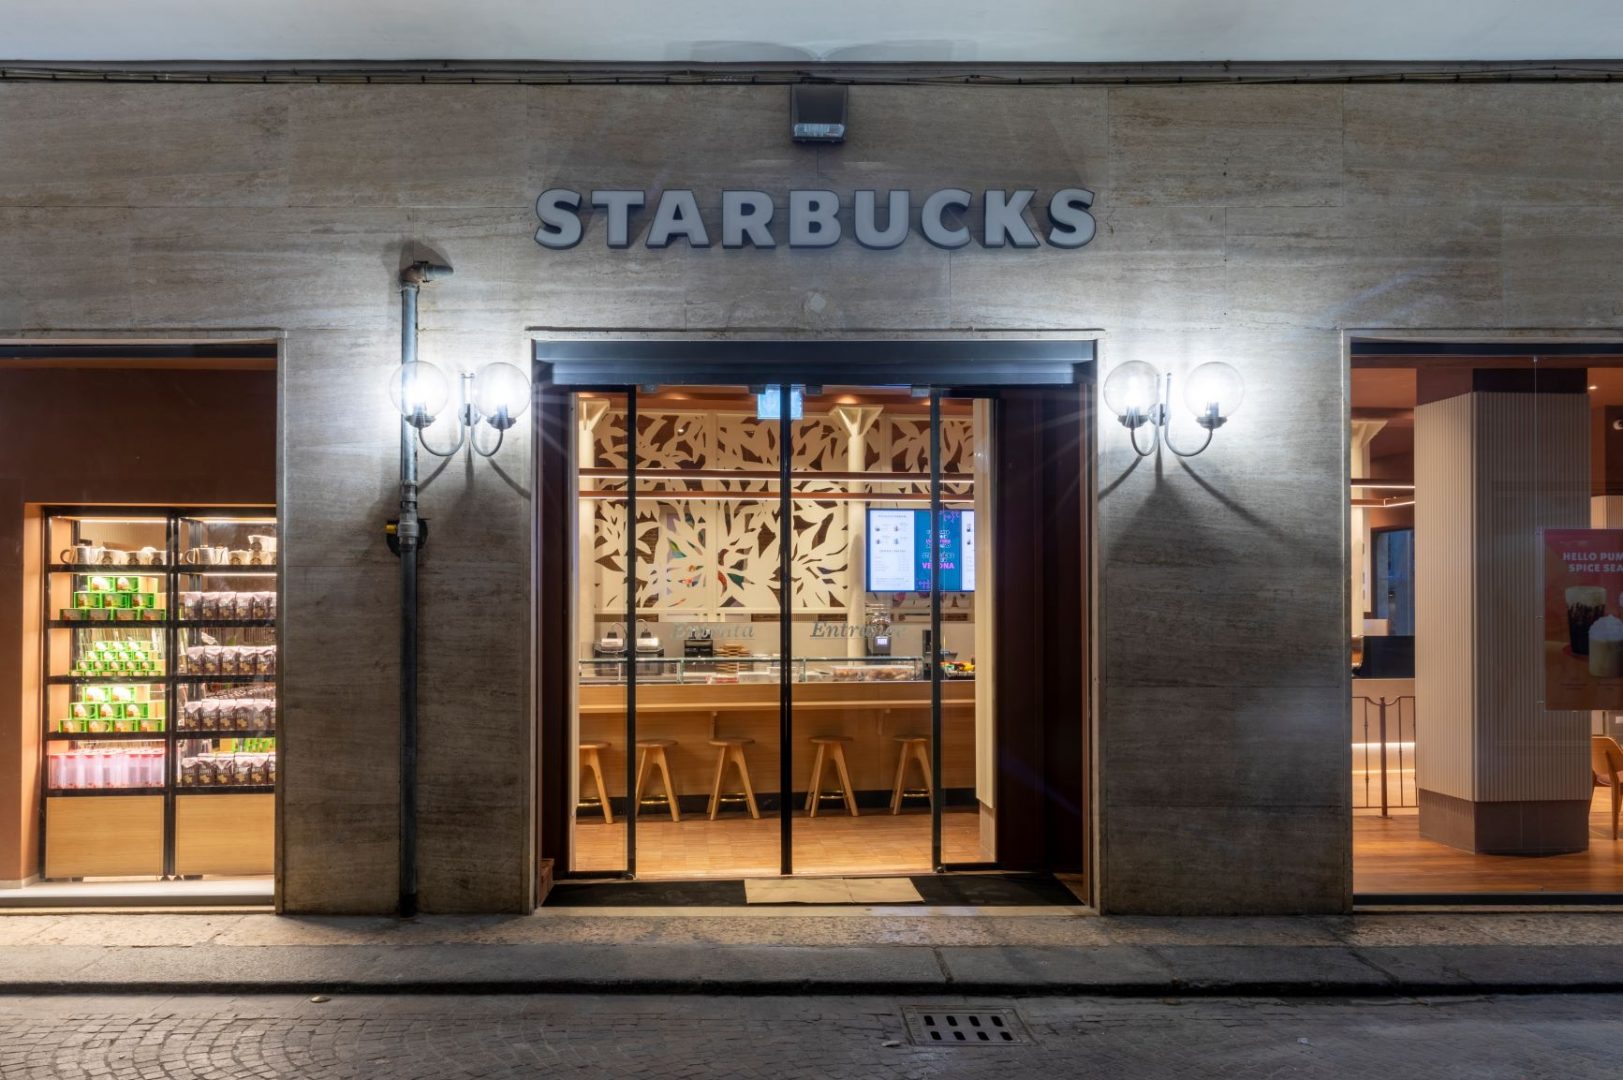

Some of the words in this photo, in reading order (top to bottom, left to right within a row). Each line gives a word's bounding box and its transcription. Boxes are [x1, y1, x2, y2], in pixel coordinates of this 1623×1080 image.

[534, 188, 1097, 249] STARBUCKS
[1562, 552, 1597, 561] HELLO
[1568, 564, 1600, 572] SPICE
[809, 621, 908, 637] Entrace
